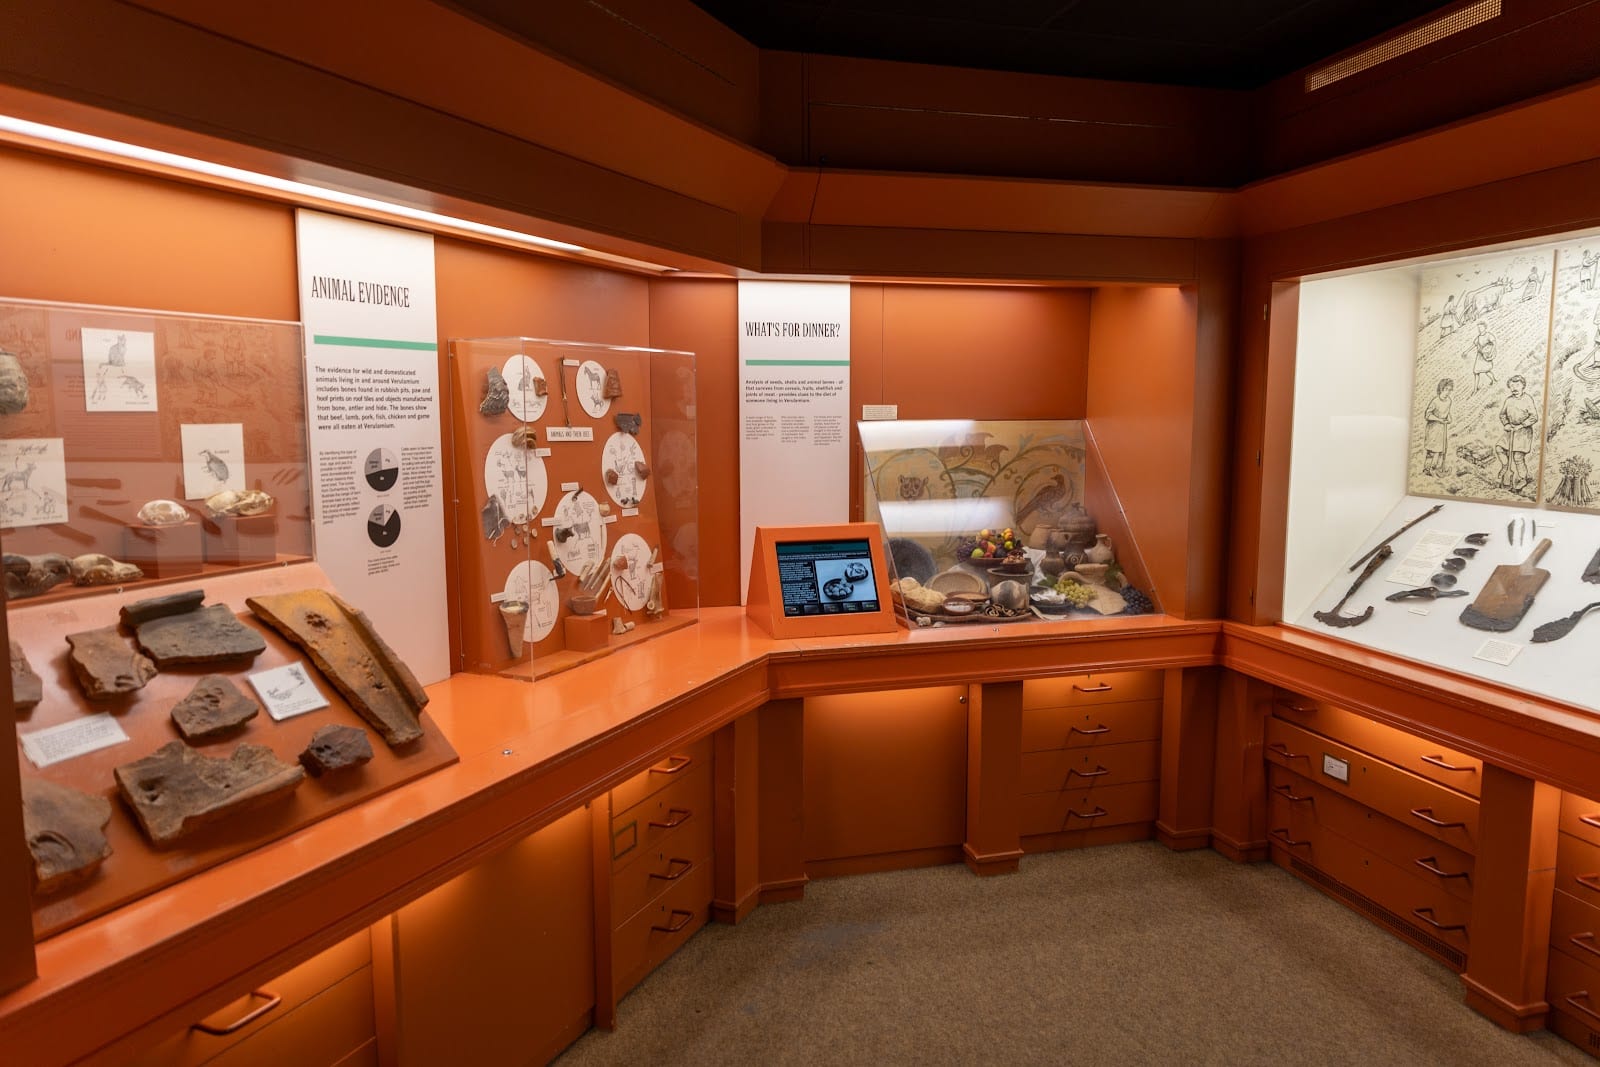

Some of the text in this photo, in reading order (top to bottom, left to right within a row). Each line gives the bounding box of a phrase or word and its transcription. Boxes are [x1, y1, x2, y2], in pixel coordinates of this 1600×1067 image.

[312, 276, 410, 307] ANIMAL EVIDENCE
[746, 322, 840, 338] WHAT'S FOR DINNER?
